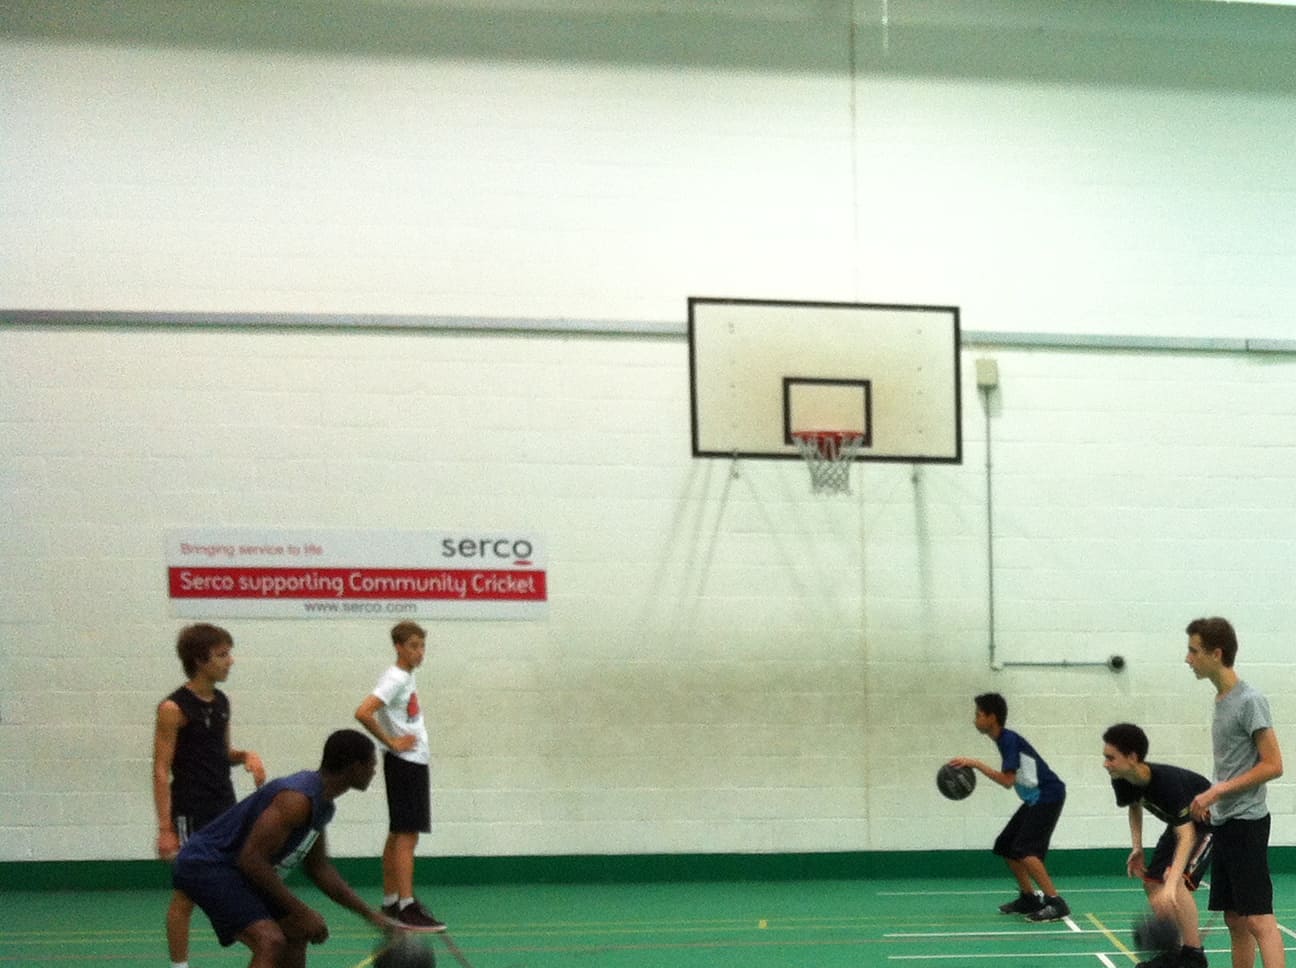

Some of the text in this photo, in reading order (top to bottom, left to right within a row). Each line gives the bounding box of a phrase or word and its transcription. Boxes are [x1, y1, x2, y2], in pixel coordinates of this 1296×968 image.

[441, 538, 533, 558] serco
[180, 571, 536, 598] Serco supporting Community Cricket
[304, 602, 417, 614] www.serco.com
